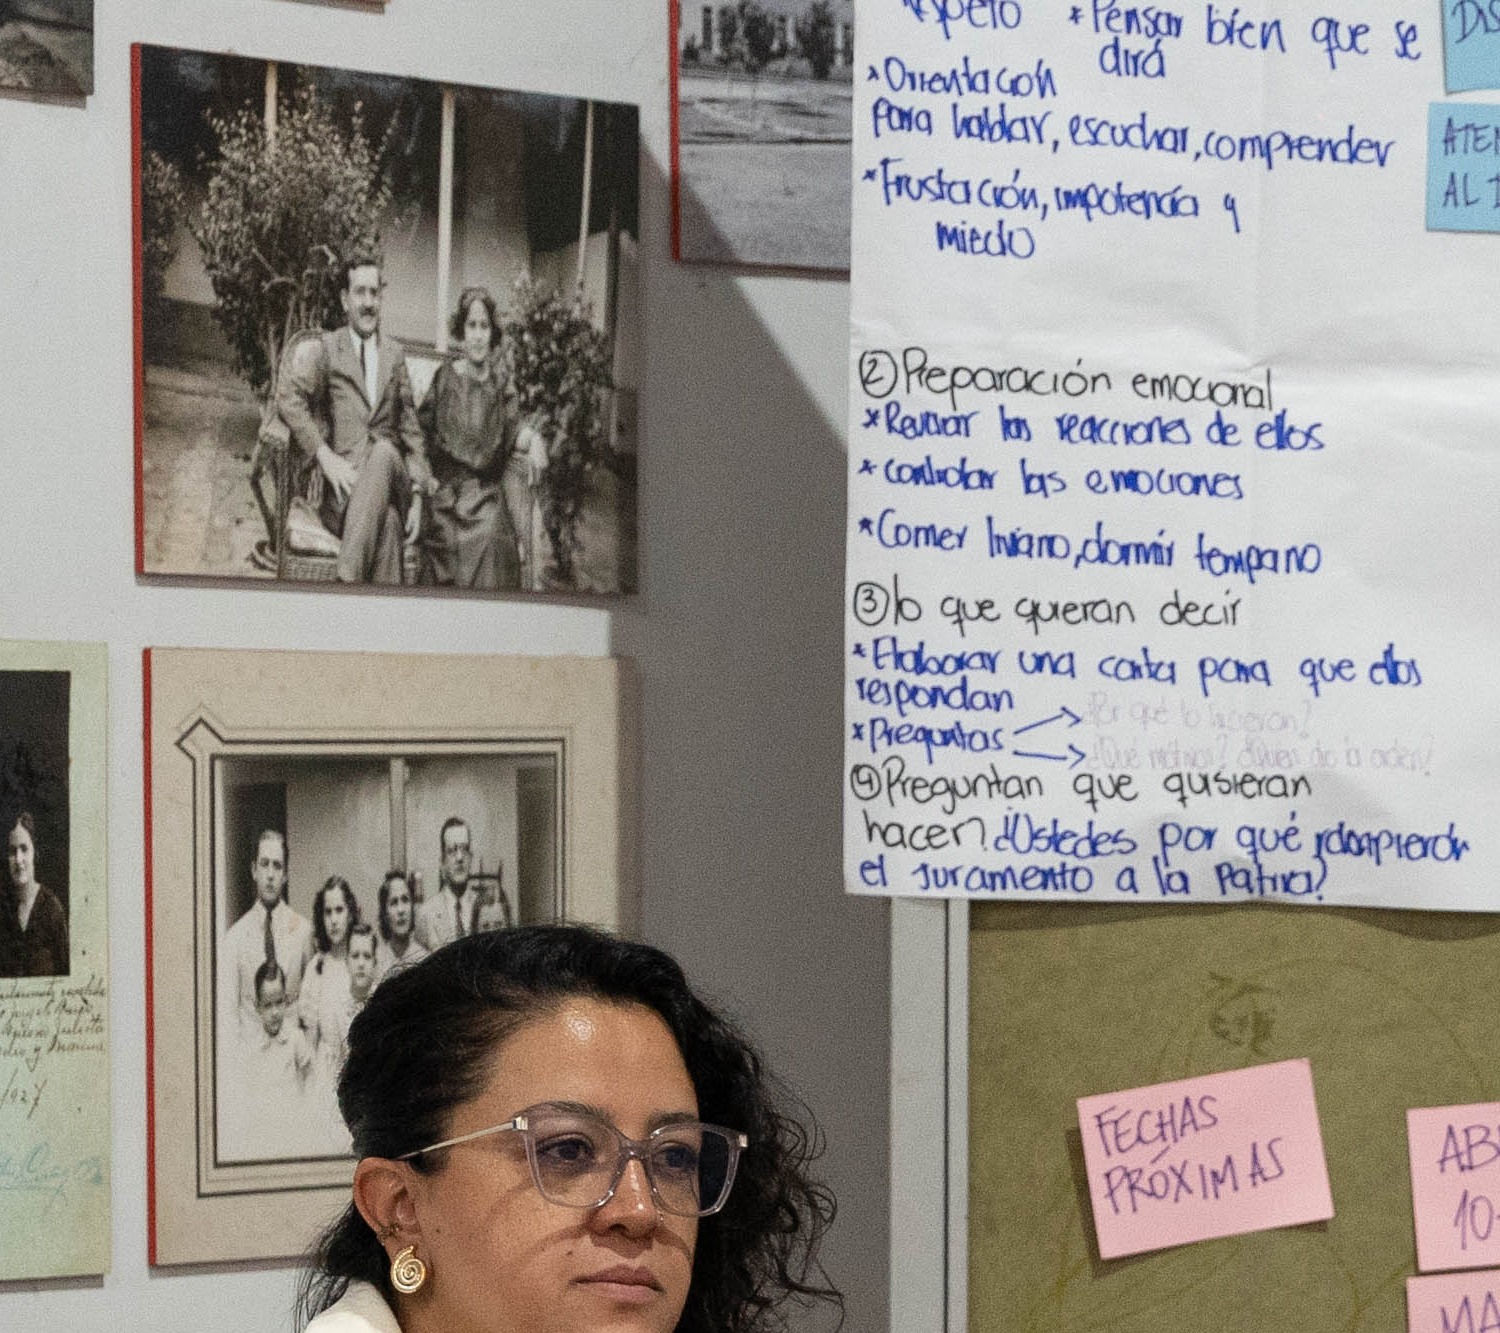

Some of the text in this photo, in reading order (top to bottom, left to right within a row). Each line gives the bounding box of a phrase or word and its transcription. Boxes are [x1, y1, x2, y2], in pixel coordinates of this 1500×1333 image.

[1098, 35, 1166, 79] dirá
[1441, 172, 1481, 209] AL
[935, 218, 1036, 259] miedo
[1131, 368, 1273, 412] emocional
[1085, 468, 1244, 500] emociones
[939, 595, 1002, 638] que
[1158, 588, 1242, 628] decir
[855, 673, 1014, 718] respondan
[1017, 650, 1076, 679] una
[1298, 657, 1357, 698] que
[1072, 772, 1139, 813] que
[1157, 822, 1219, 868] por
[858, 853, 1191, 897] el a la
[1093, 1091, 1219, 1160] FECHAS
[1100, 1133, 1285, 1215] PRÓXIMAS
